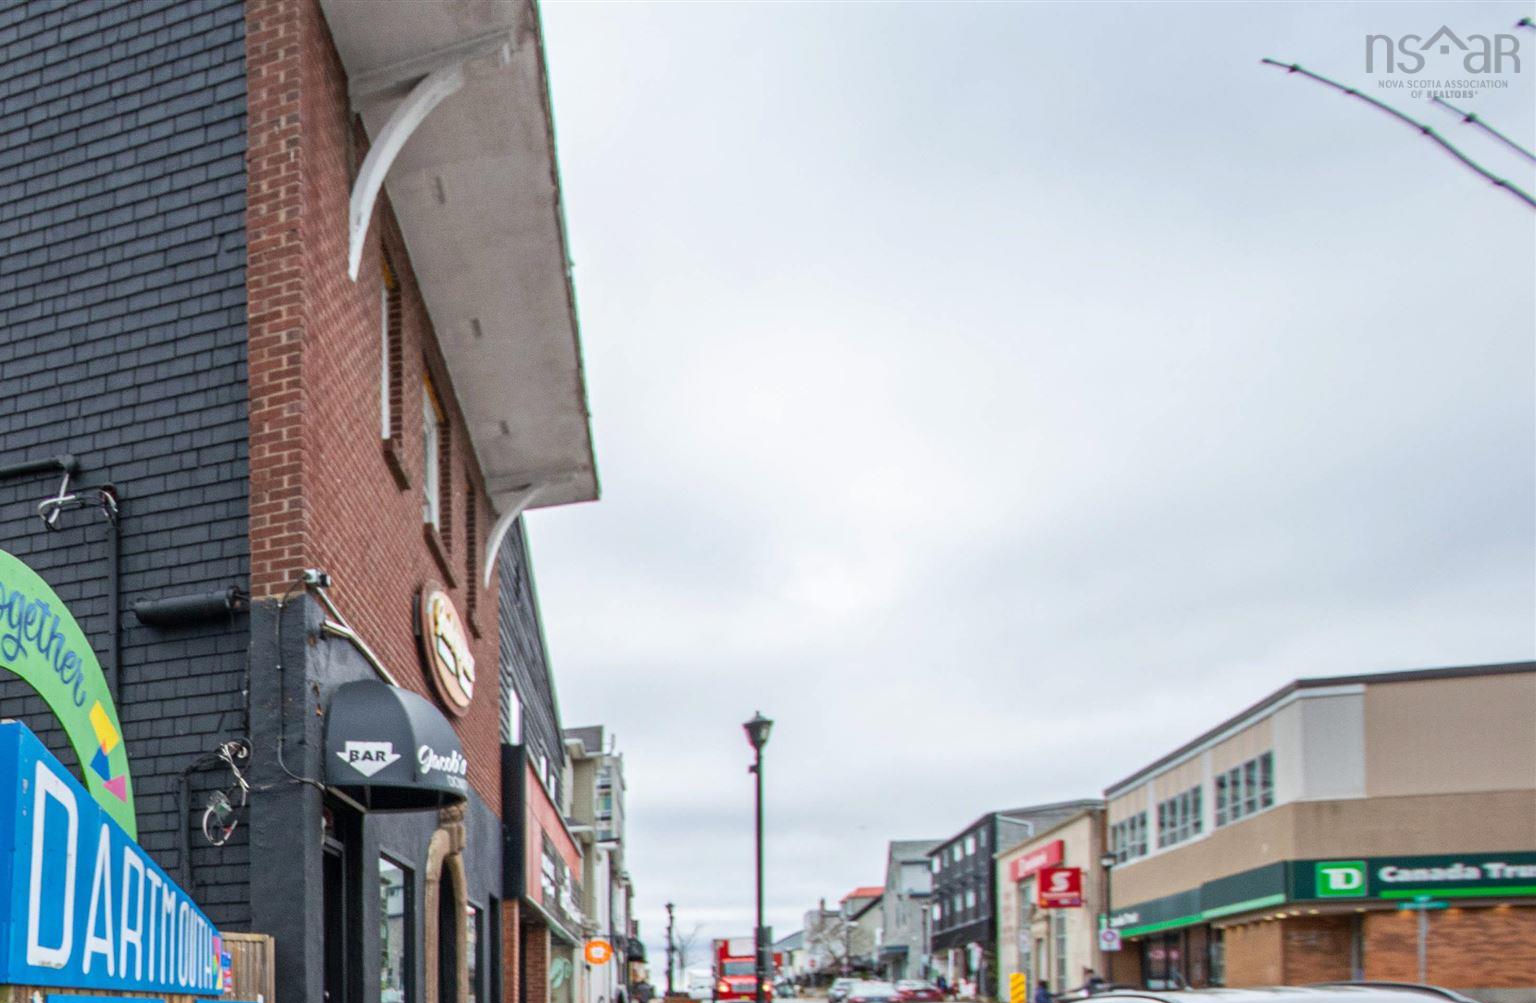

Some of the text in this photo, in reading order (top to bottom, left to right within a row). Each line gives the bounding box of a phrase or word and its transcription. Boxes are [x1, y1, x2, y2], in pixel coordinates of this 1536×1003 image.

[349, 750, 386, 761] BAR
[27, 760, 213, 990] DARTMOUTH
[1321, 868, 1362, 889] TD
[1378, 863, 1481, 882] Canada
